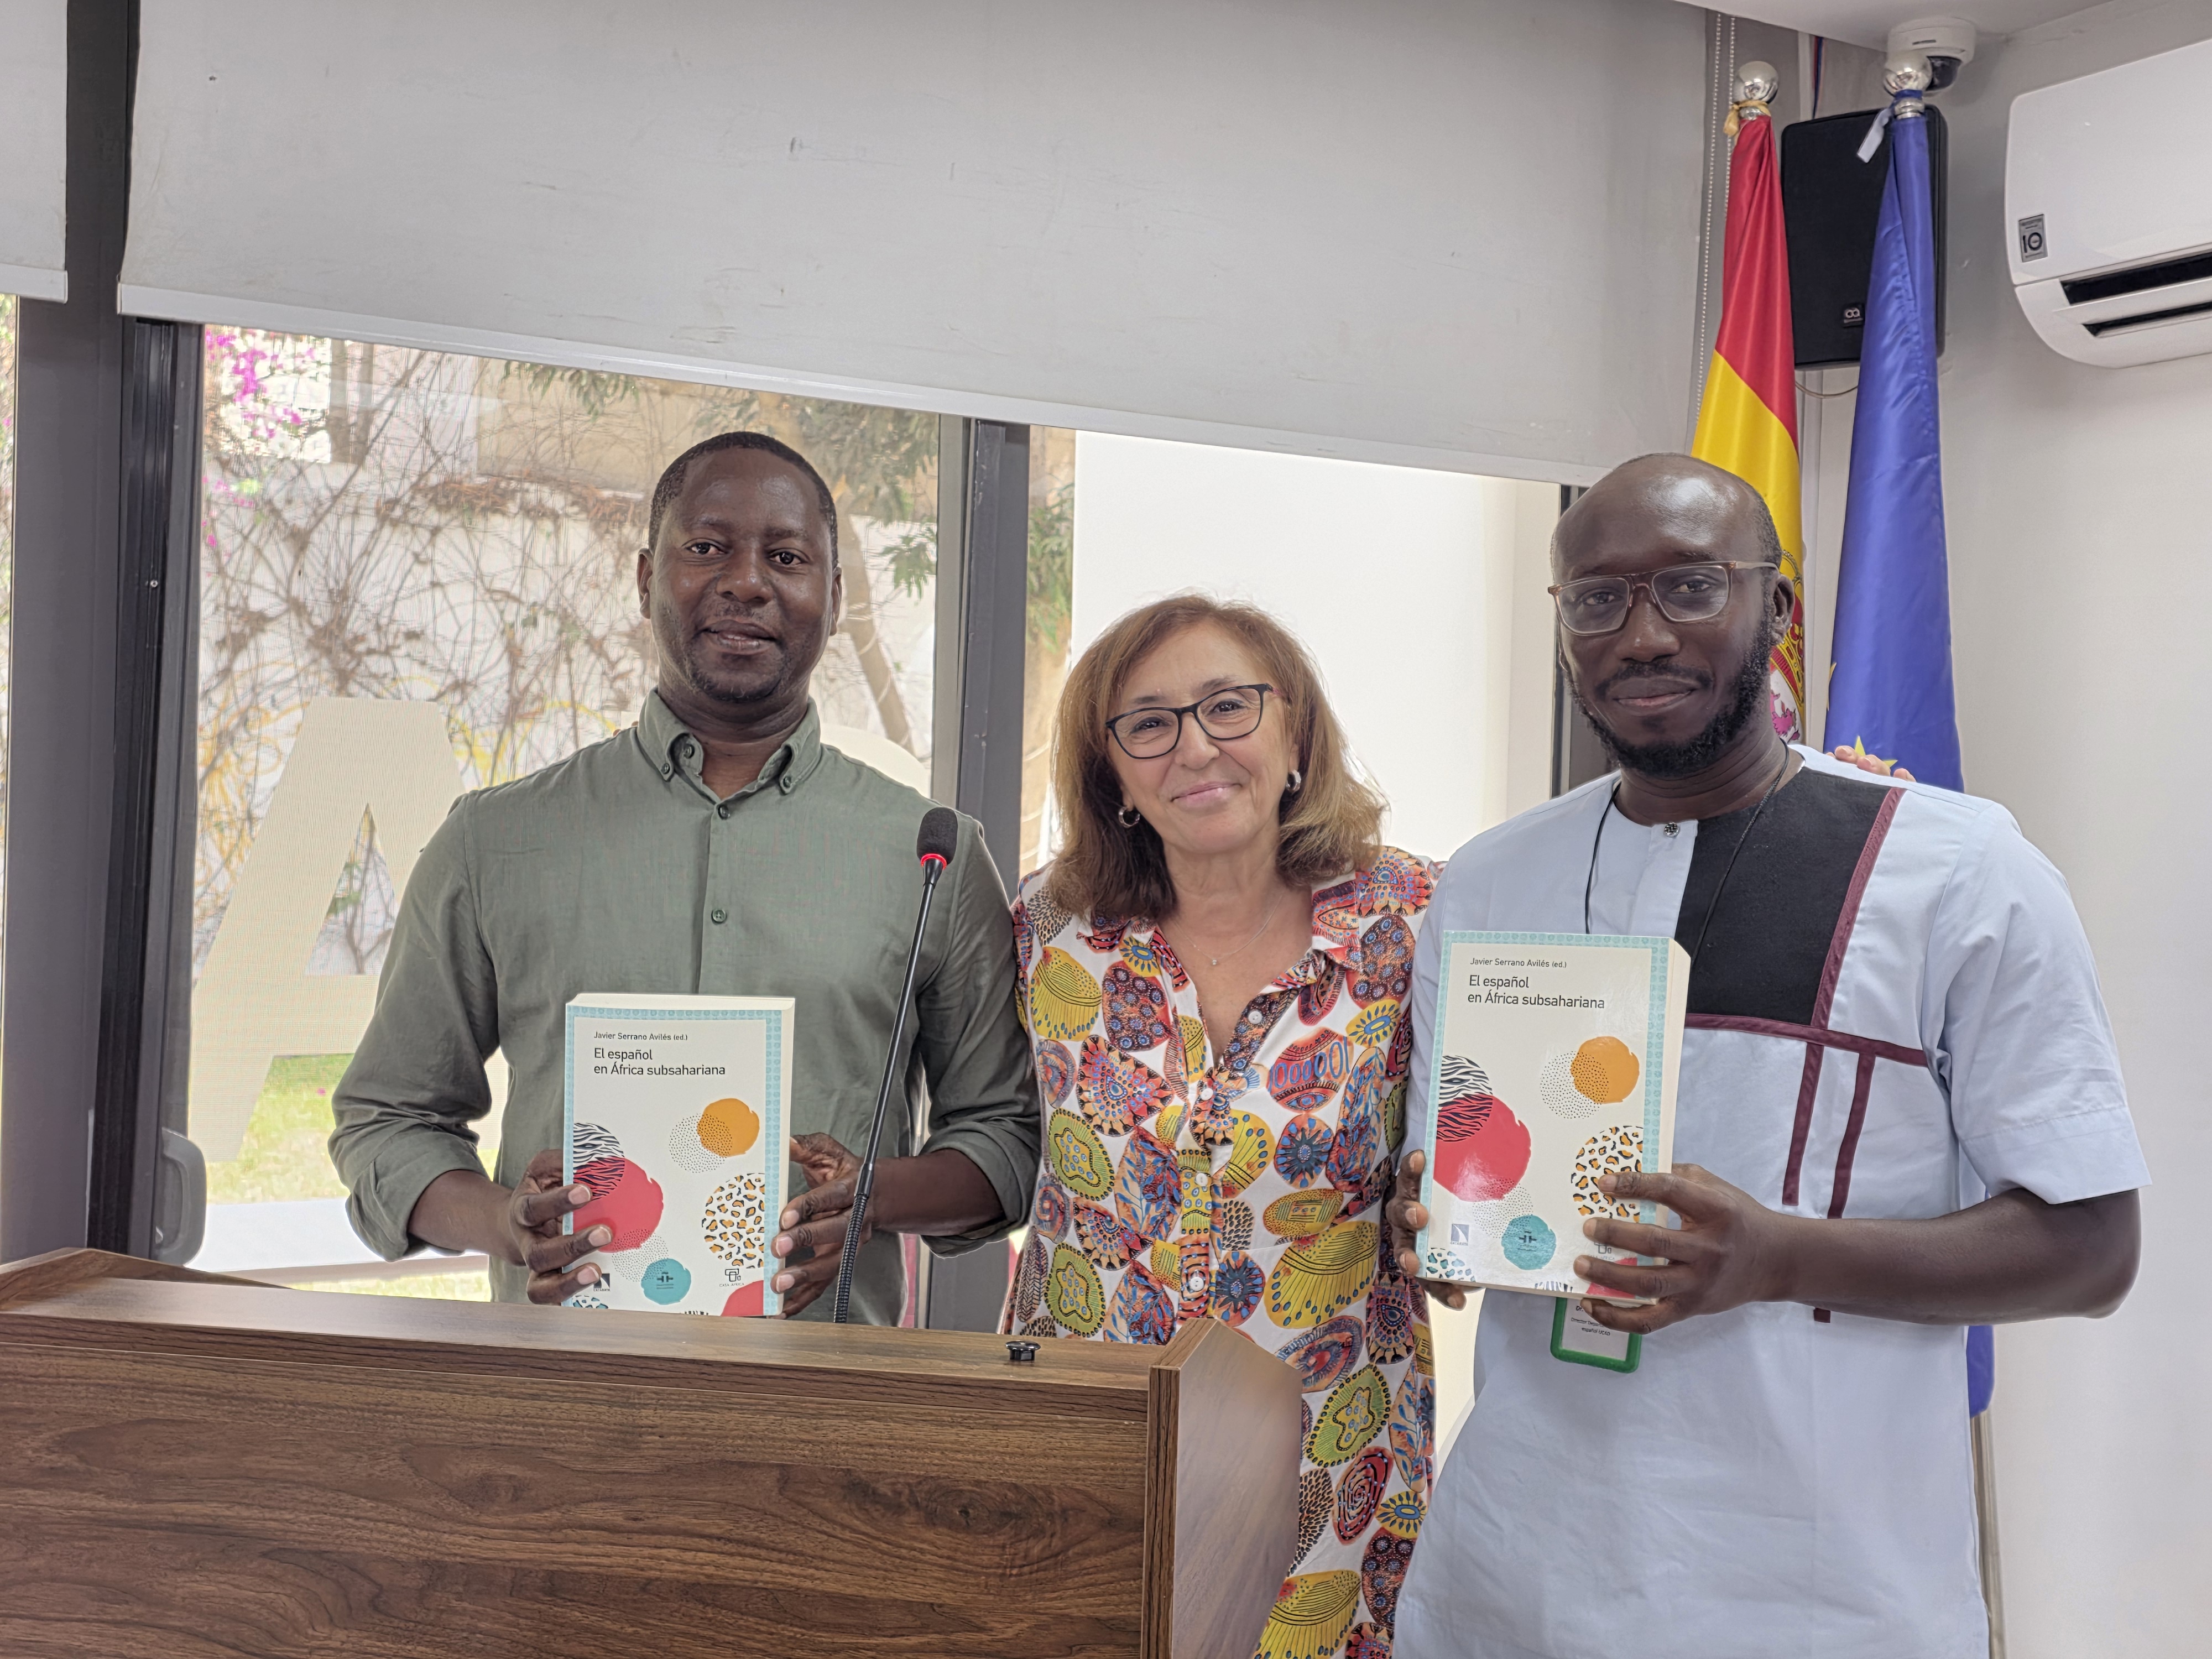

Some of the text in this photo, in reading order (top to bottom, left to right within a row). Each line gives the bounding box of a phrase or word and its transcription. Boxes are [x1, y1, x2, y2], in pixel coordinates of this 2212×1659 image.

[1495, 958, 1525, 967] Serrano
[1469, 974, 1529, 990] El español
[1468, 989, 1605, 1009] en África subsahariana
[594, 1047, 653, 1062] El español
[594, 1061, 726, 1075] en África subsahariana
